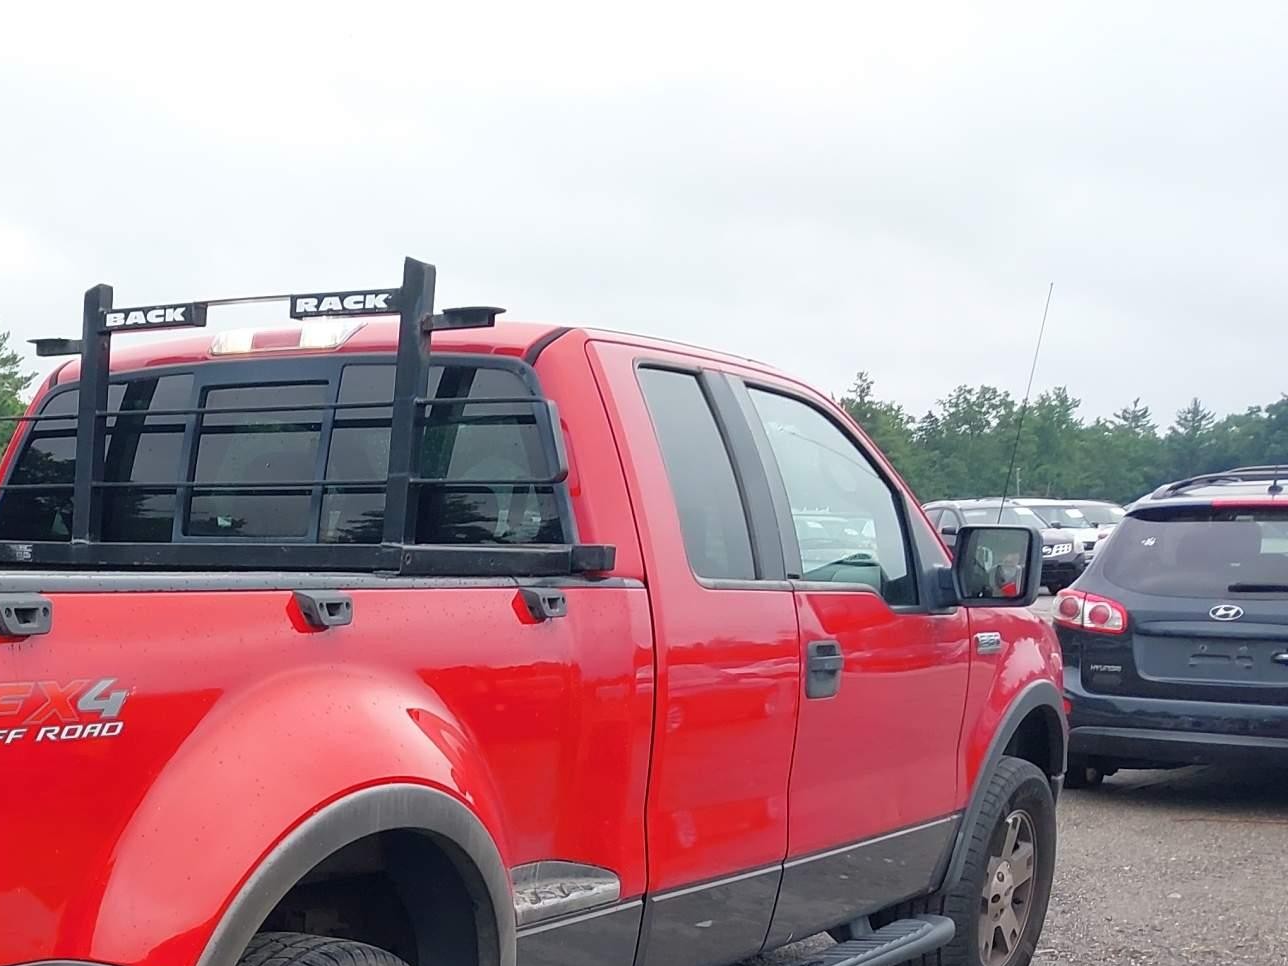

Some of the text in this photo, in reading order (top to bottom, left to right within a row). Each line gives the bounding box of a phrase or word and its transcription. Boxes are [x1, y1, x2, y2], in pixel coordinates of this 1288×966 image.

[105, 293, 389, 327] BACK RACK
[35, 720, 125, 742] ROAD
